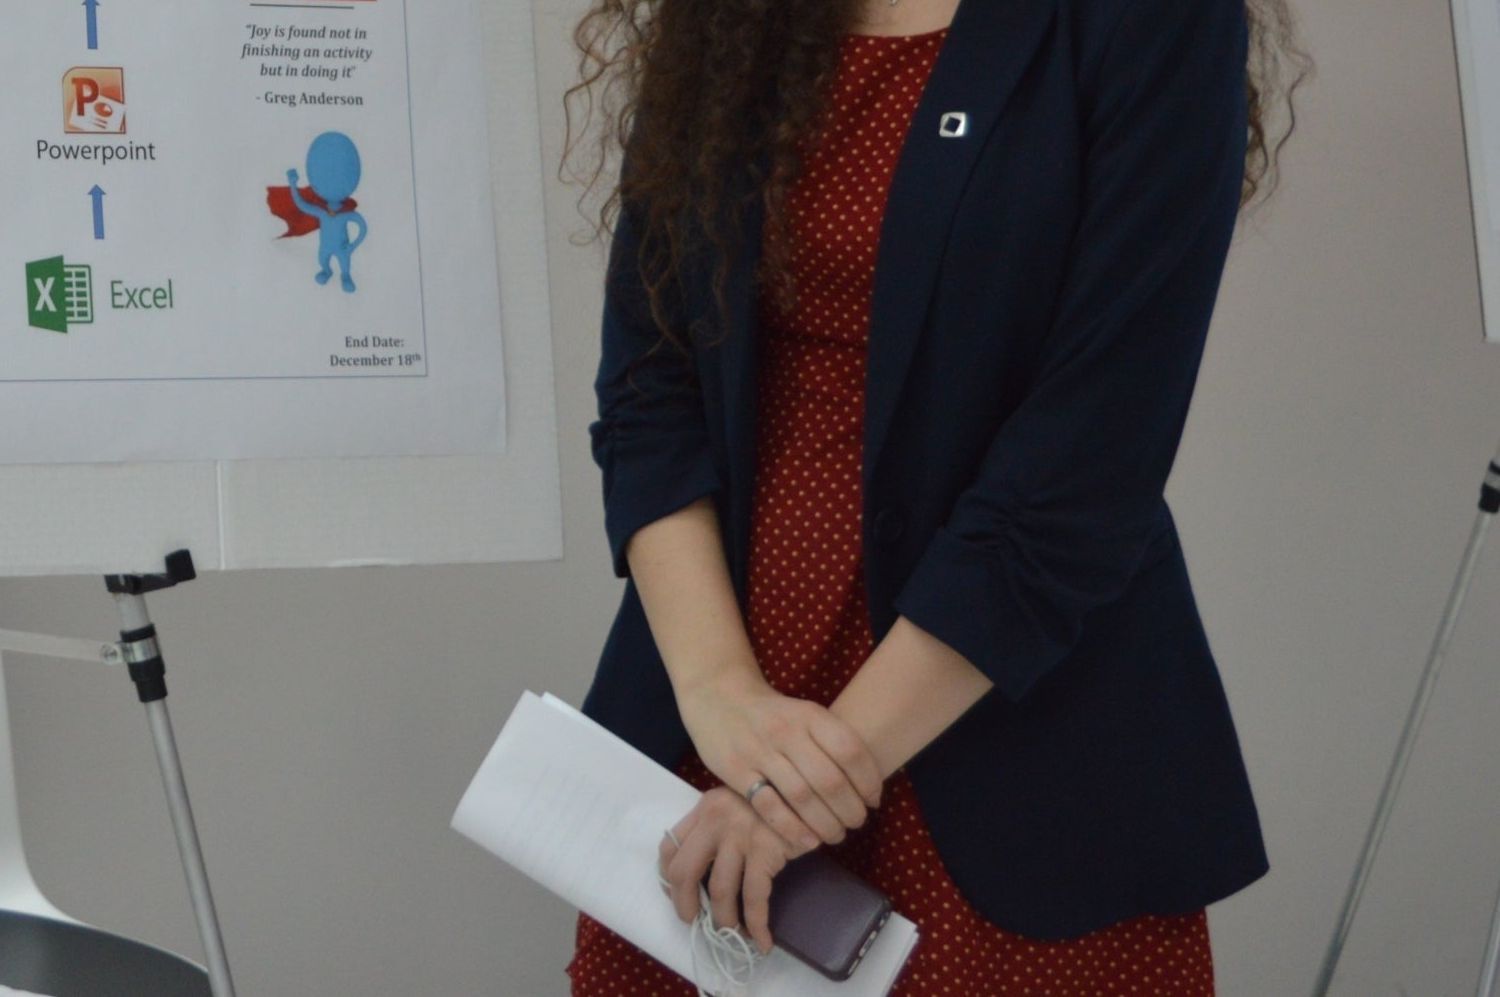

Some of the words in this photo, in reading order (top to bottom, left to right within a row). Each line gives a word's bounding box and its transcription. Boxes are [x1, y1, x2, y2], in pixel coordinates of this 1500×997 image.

[273, 24, 285, 38] is
[286, 24, 327, 41] found
[328, 27, 351, 40] not
[353, 26, 367, 40] in
[240, 42, 300, 61] finishing
[302, 47, 320, 58] an
[322, 46, 373, 62] activity
[259, 62, 282, 77] but
[284, 64, 298, 77] in
[300, 63, 338, 82] doing
[263, 90, 297, 108] Greg
[298, 91, 364, 106] Anderson
[36, 138, 156, 166] Powerpoint
[109, 278, 173, 310] Excel
[344, 335, 369, 348] End
[371, 335, 404, 348] Date:
[329, 353, 394, 367] December
